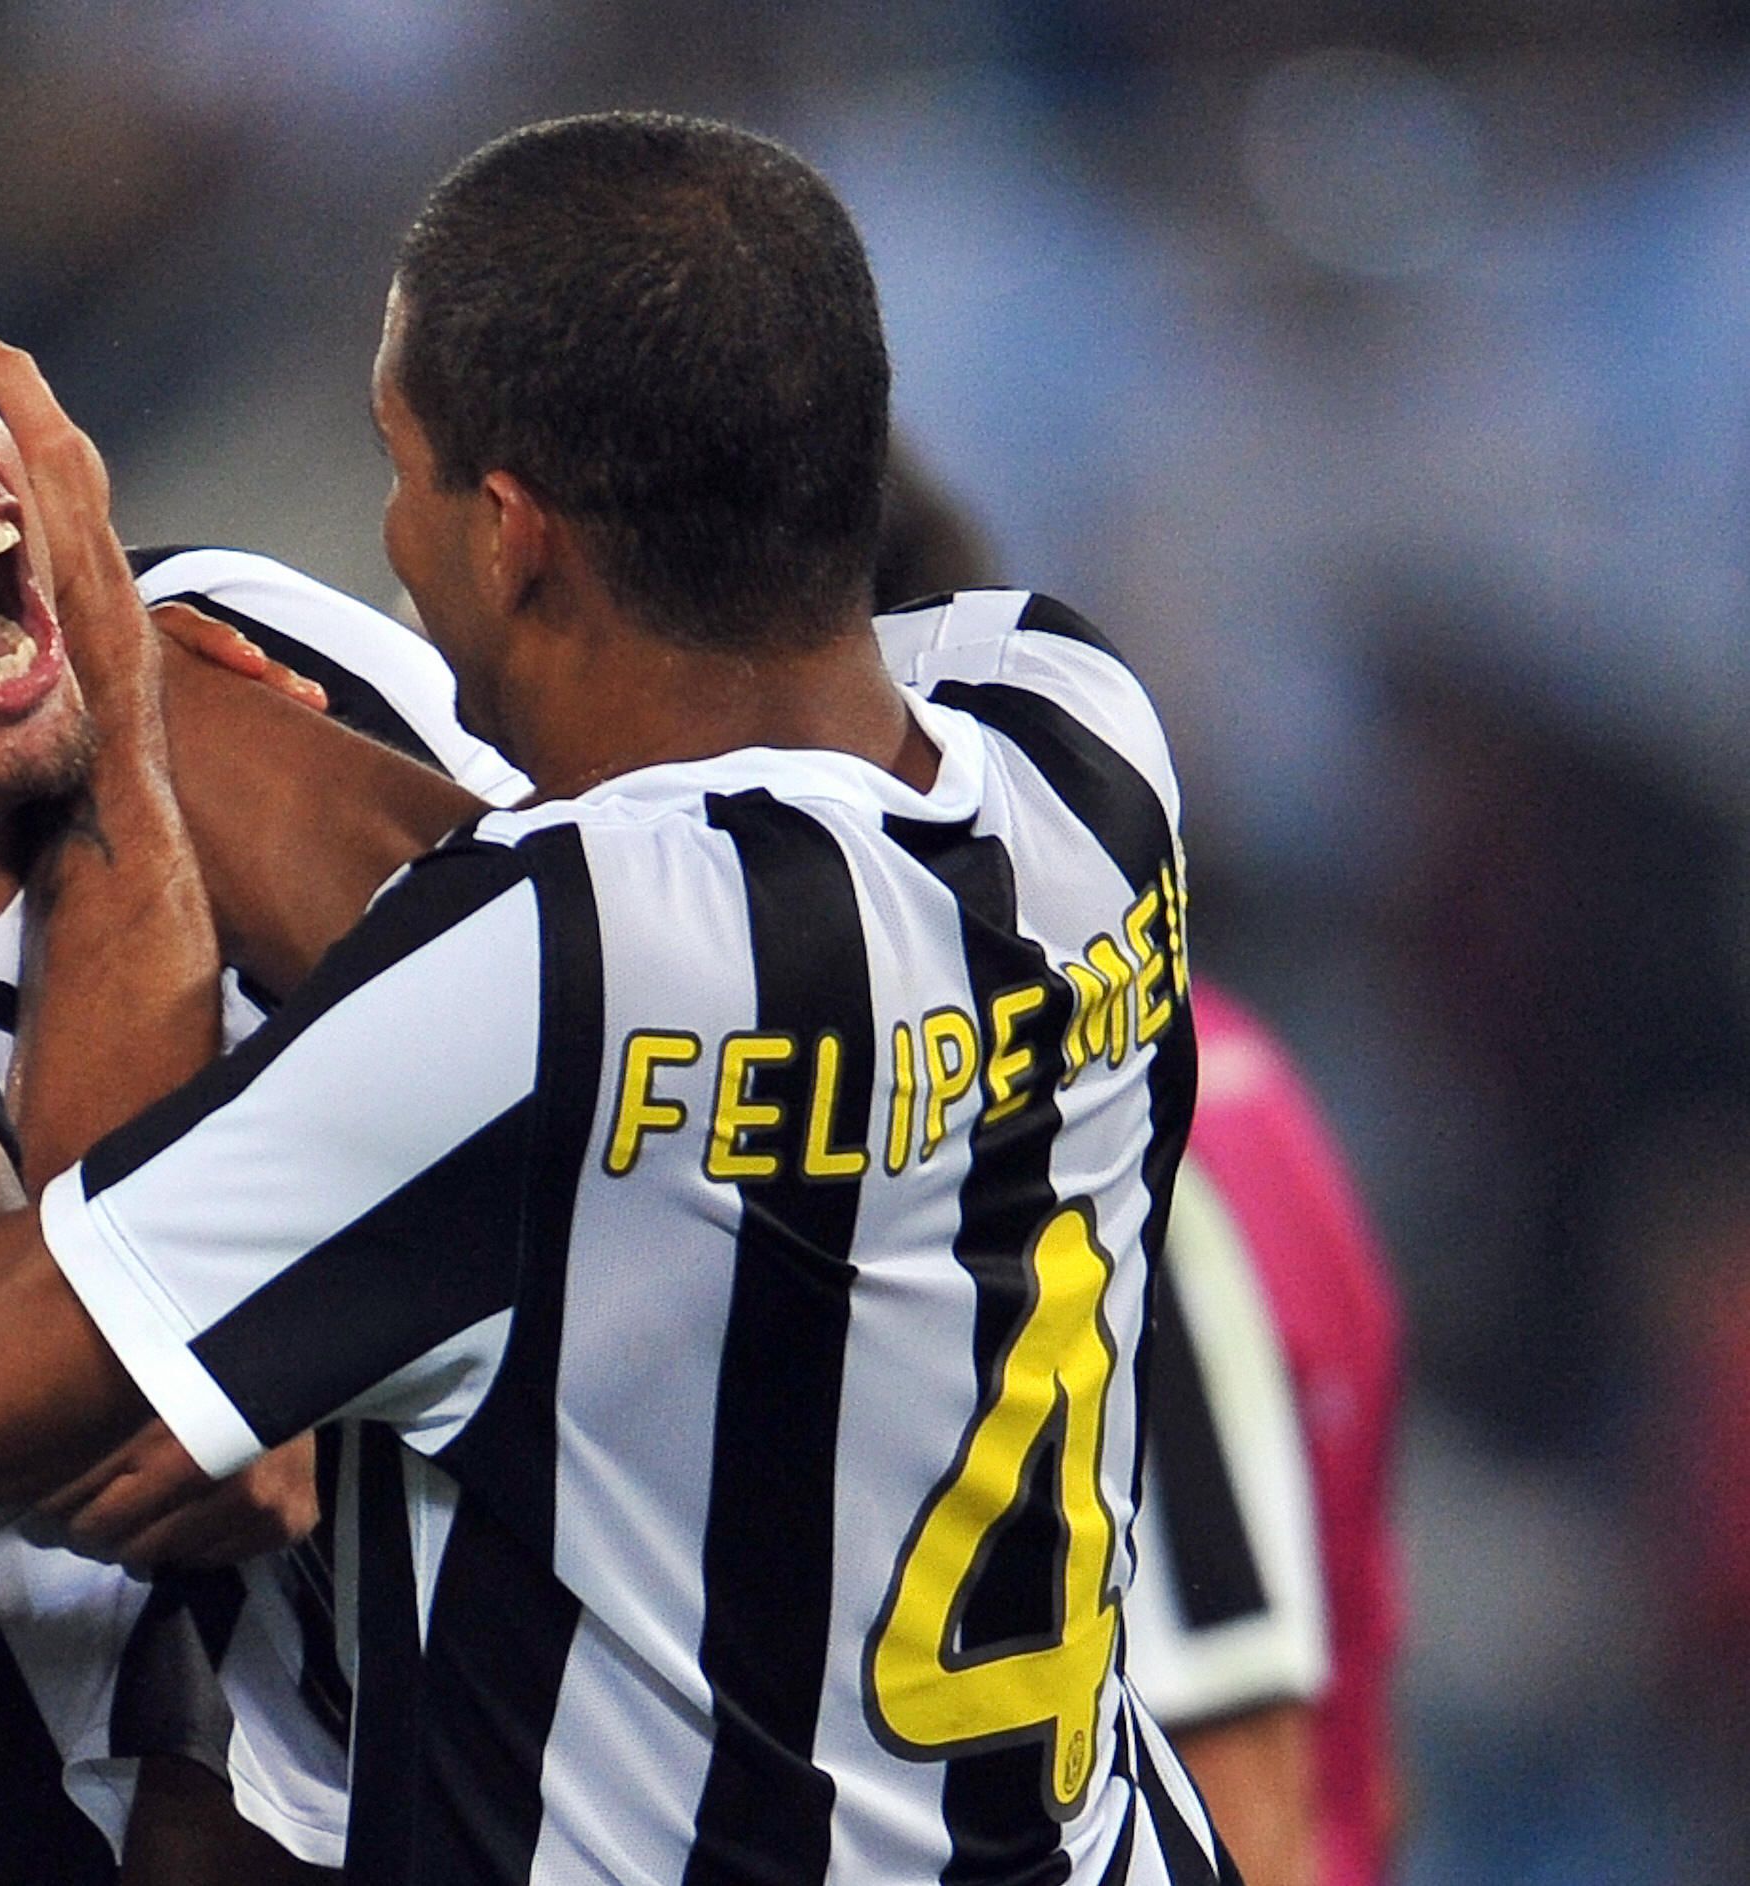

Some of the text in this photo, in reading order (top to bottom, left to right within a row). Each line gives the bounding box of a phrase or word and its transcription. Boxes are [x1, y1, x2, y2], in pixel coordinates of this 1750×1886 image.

[604, 860, 1188, 1178] FELIPE MEL
[864, 1195, 1117, 1823] 4
